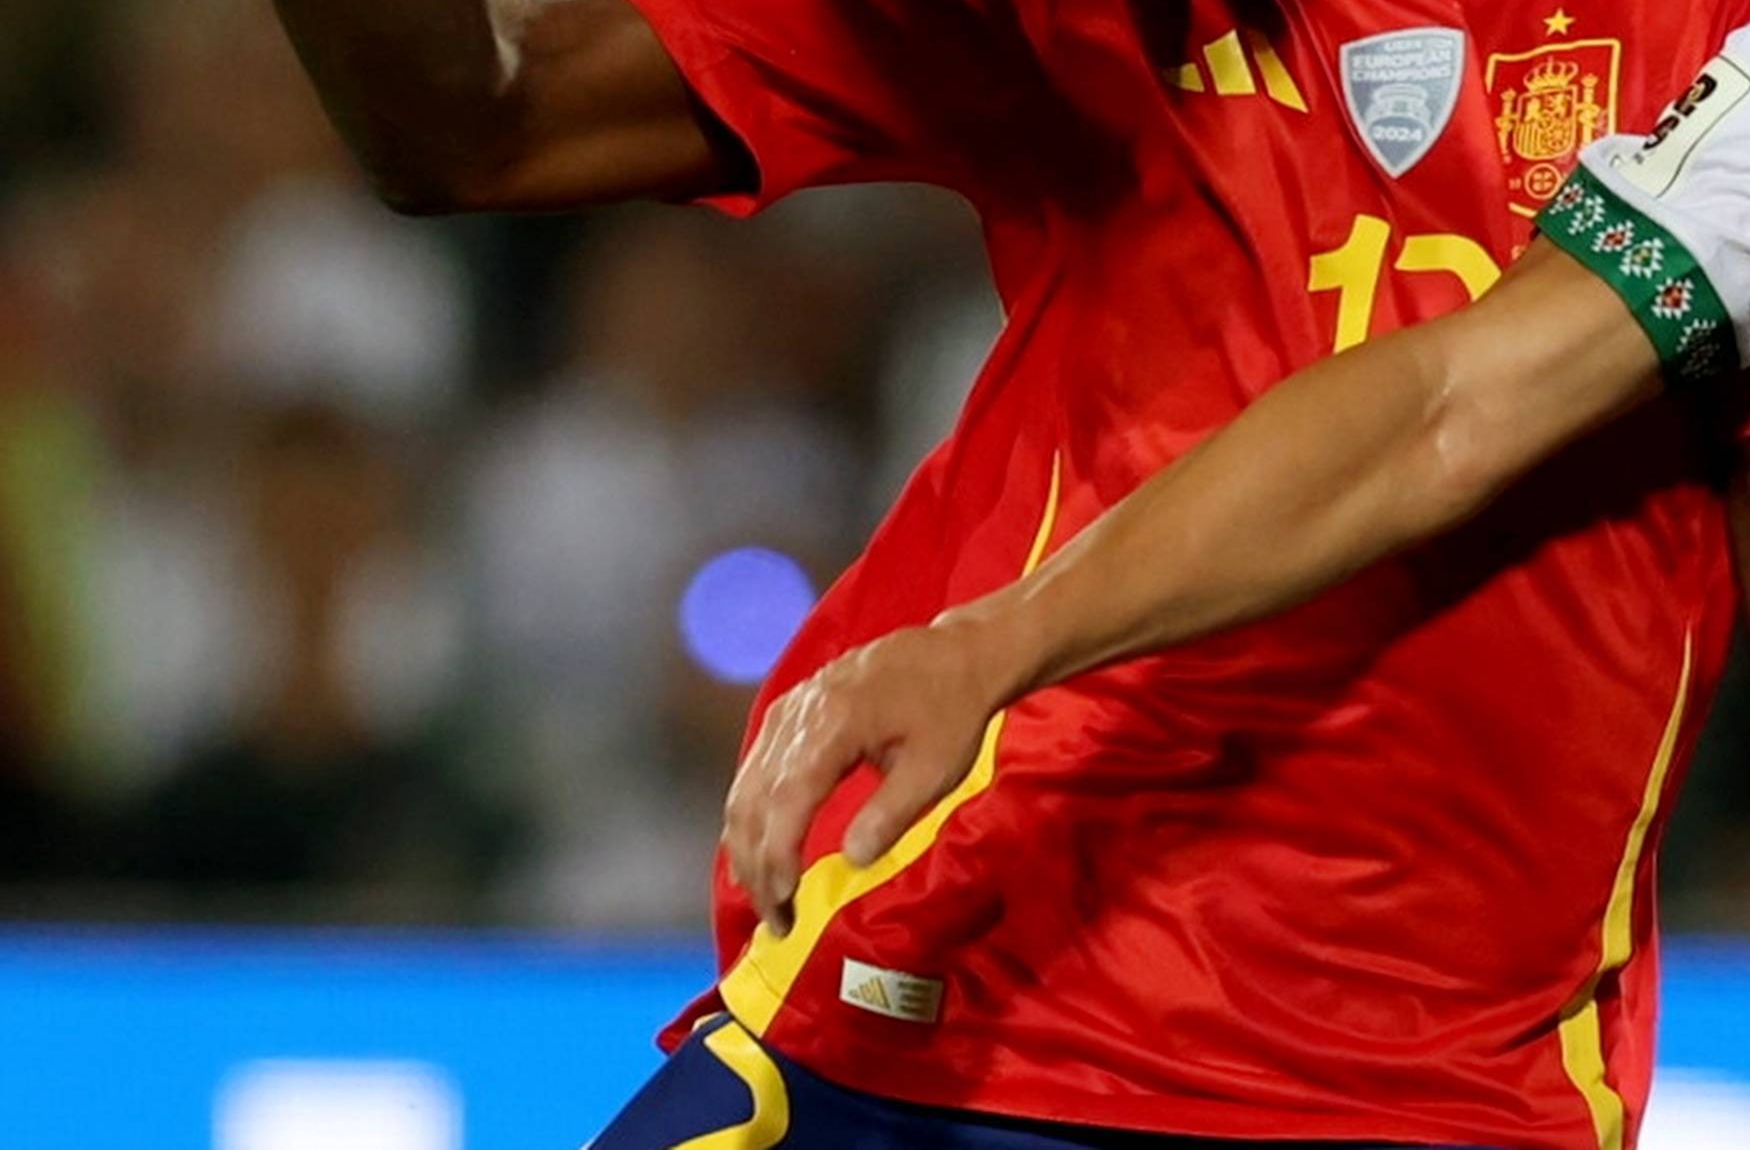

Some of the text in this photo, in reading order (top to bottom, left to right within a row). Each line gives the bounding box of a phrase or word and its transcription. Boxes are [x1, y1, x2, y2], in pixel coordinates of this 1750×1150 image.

[1352, 50, 1452, 68] EUROPEAN
[1351, 65, 1453, 82] CHAMPIONS
[1372, 125, 1423, 142] 2024
